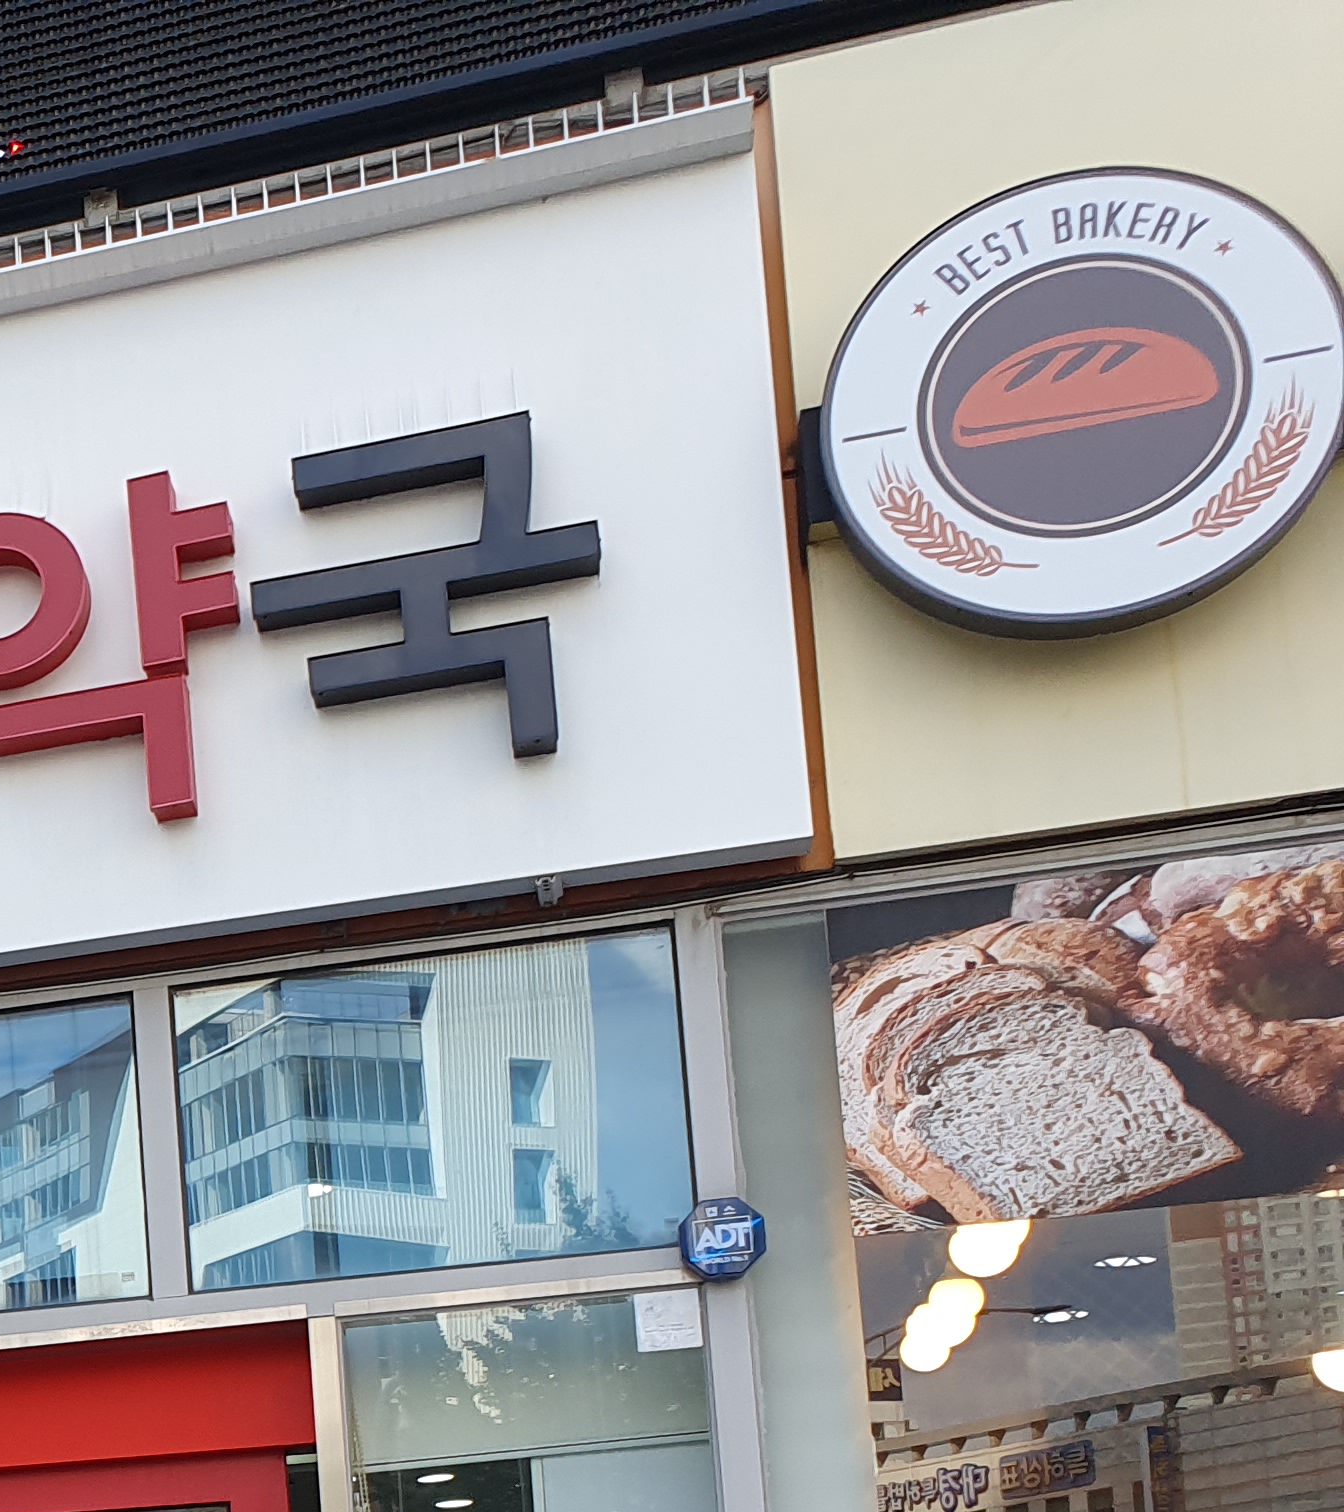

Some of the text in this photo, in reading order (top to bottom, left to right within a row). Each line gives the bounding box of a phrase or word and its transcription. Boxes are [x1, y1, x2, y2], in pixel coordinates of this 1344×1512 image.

[932, 199, 1212, 297] BEST BAKERY
[694, 1222, 753, 1256] ADT
